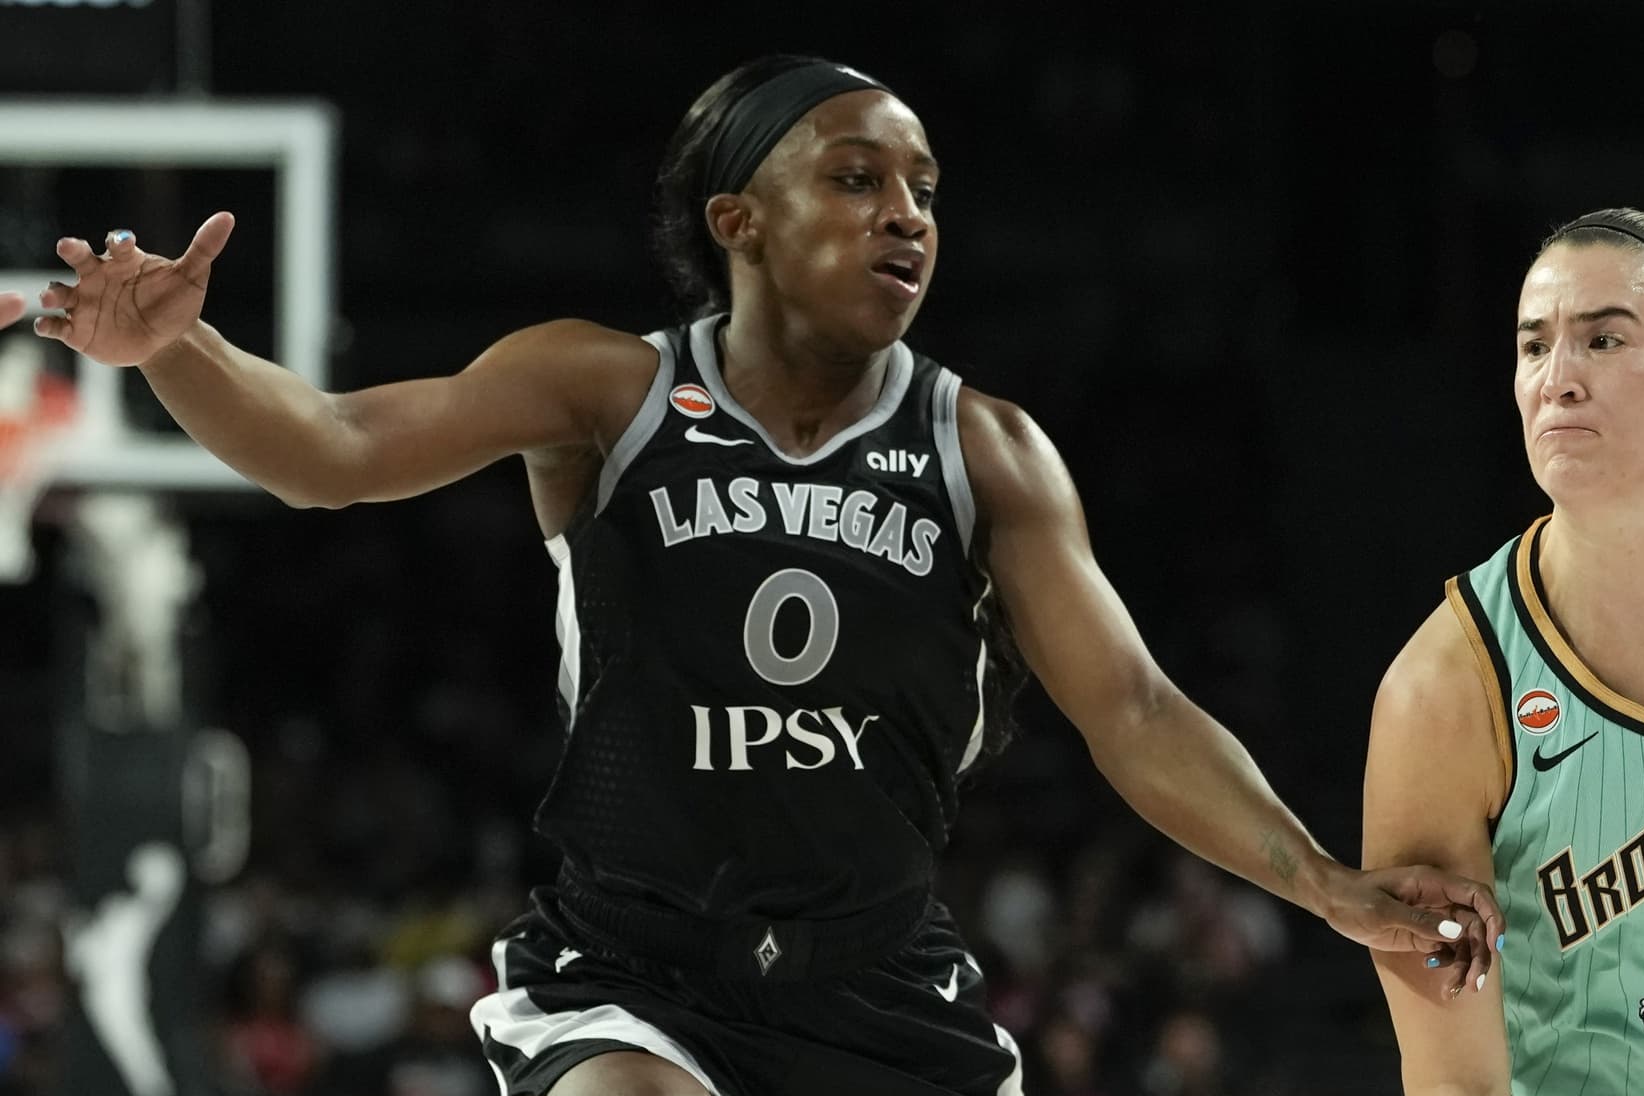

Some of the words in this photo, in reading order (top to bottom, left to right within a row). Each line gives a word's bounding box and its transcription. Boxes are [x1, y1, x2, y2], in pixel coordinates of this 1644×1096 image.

[866, 450, 930, 478] ally
[649, 477, 767, 548] LAS
[772, 483, 942, 577] VEGAS
[744, 568, 840, 686] 0
[691, 705, 880, 771] IPSY
